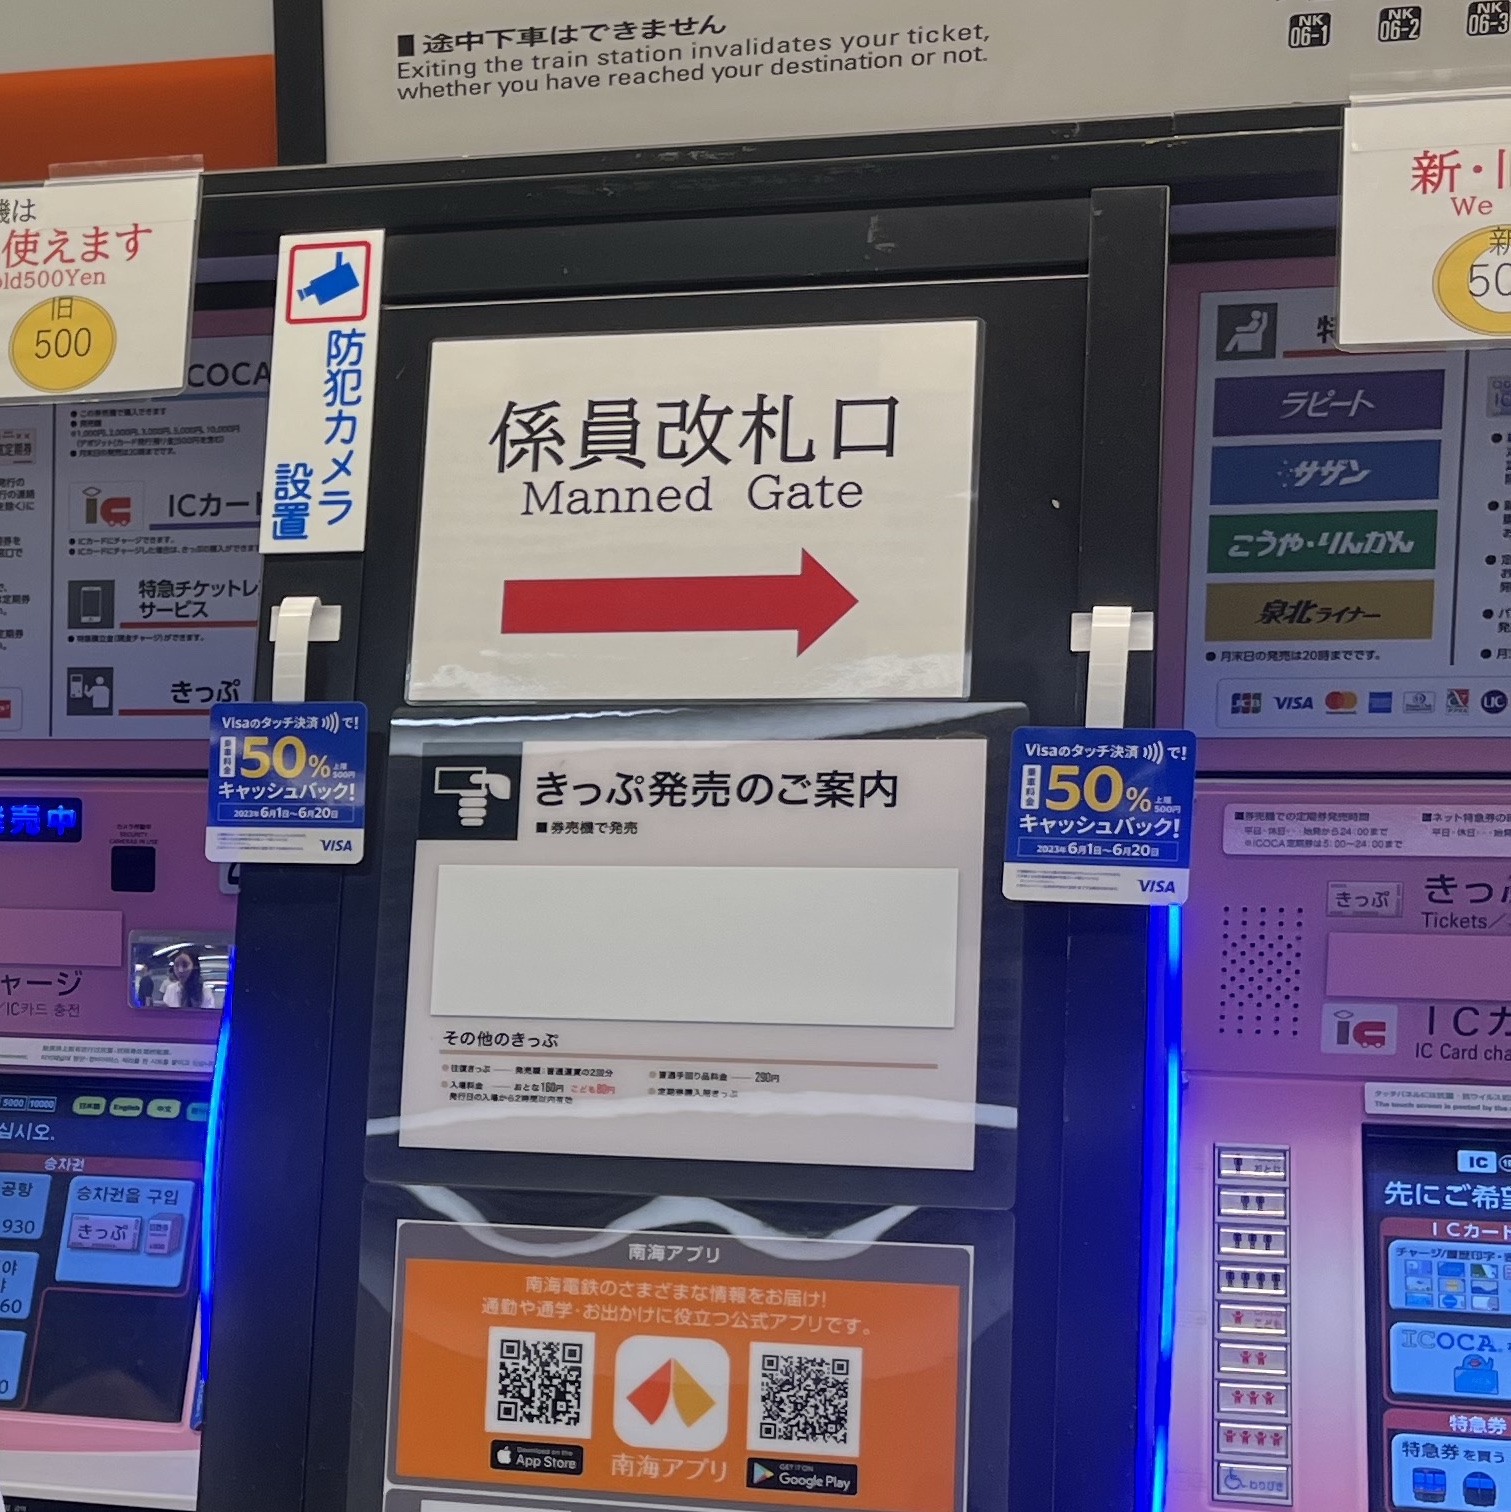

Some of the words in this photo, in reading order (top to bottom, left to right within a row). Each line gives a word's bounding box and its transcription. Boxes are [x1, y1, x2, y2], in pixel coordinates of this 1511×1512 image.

[1388, 8, 1414, 20] NK
[1476, 1, 1503, 13] NK
[1298, 14, 1325, 26] NK
[1379, 19, 1420, 41] 06-2
[1468, 13, 1510, 35] 06-3
[422, 14, 727, 55] 途中下車はできません
[1290, 26, 1329, 47] 06-1
[397, 60, 477, 81] Exiting
[486, 55, 524, 75] the
[532, 50, 589, 71] train
[597, 44, 682, 67] station
[691, 36, 833, 60] invalidates
[840, 31, 901, 54] your
[906, 23, 991, 46] ticket,
[397, 78, 492, 101] whether
[497, 78, 539, 98] you
[546, 71, 601, 91] have
[608, 63, 705, 87] reached
[710, 62, 765, 85] your
[770, 50, 903, 76] destination
[911, 50, 936, 67] or
[942, 44, 989, 65] not.
[1450, 196, 1494, 216] We
[33, 328, 92, 359] 500
[188, 361, 272, 388] COCA
[1279, 388, 1376, 420] ラピート
[319, 329, 367, 526] 防犯カメラ
[488, 393, 901, 474] 係員改札口
[1292, 459, 1371, 487] サザン
[271, 461, 314, 541] 設置
[521, 476, 713, 517] Manned
[748, 474, 864, 511] Gate
[139, 600, 209, 619] サービス
[1255, 599, 1382, 626] 泉北ライナー
[170, 679, 241, 704] きっぷ
[1272, 696, 1314, 711] VISA
[221, 716, 319, 731] Visaのタッチ決済
[240, 735, 332, 779] 50%
[1025, 743, 1139, 760] Visaのタッチ決済
[218, 781, 355, 802] キャッシュバック!
[535, 769, 899, 809] きっぷ発売のご案内
[1045, 764, 1152, 812] 50%
[550, 820, 638, 836] 券売機で発売
[1019, 813, 1181, 839] キャッシュバック!
[319, 839, 353, 852] VISA
[1136, 879, 1176, 893] VISA
[1335, 890, 1391, 909] きっぷ
[443, 1030, 559, 1049] その他のきっぷ
[1416, 1042, 1433, 1059] IC
[1439, 1042, 1478, 1061] Card
[1469, 1155, 1489, 1169] IC
[1, 1179, 34, 1197] 공항
[147, 1187, 179, 1206] 구입
[2, 1219, 36, 1235] 930
[76, 1223, 130, 1242] きっぷ
[628, 1243, 721, 1264] 南海アプリ
[1401, 1329, 1498, 1353] ICOCA
[1448, 1414, 1507, 1436] 特急券
[515, 1453, 541, 1469] App
[543, 1455, 577, 1470] Store
[610, 1453, 728, 1483] 南海アプリ
[778, 1472, 823, 1489] Google
[825, 1475, 850, 1491] Play
